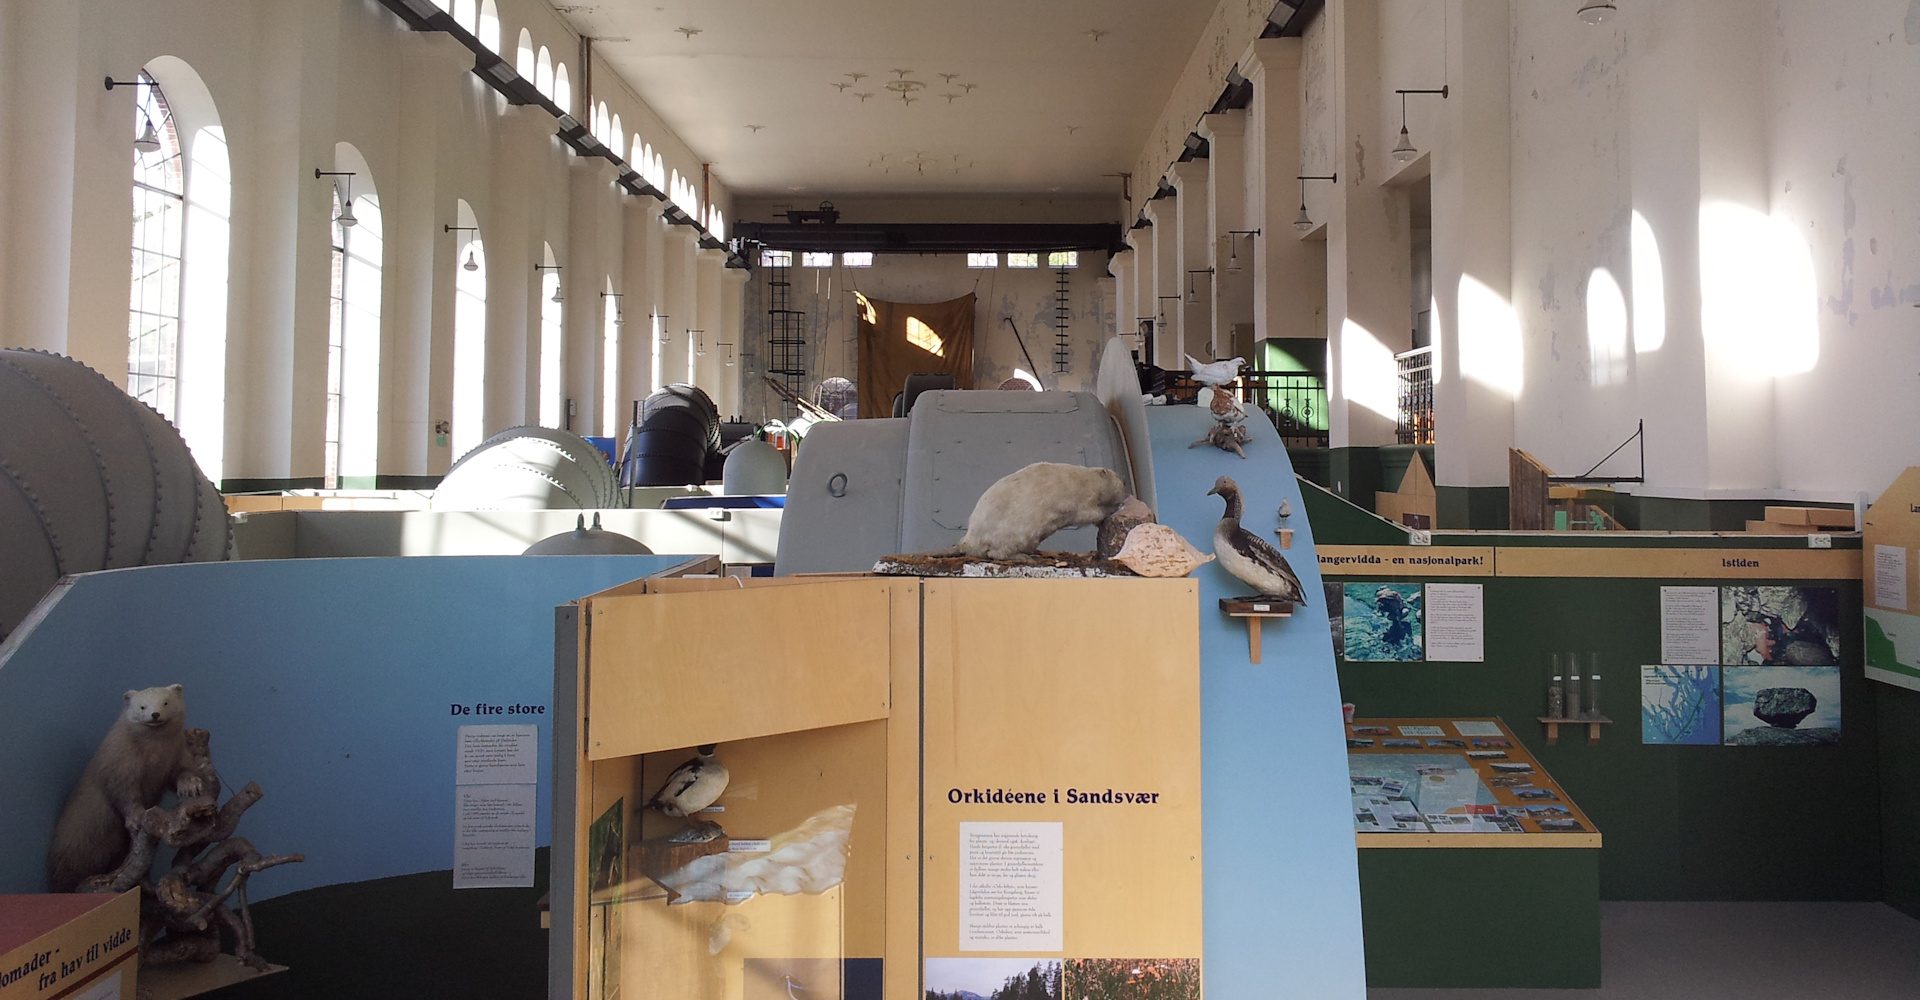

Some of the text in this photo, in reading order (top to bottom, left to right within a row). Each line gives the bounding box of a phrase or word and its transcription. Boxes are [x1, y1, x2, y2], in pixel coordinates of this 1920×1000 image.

[1392, 556, 1405, 564] en
[1409, 556, 1484, 567] nasjonalpark!
[1722, 558, 1760, 568] Istiden
[450, 702, 546, 716] De fire store
[947, 788, 1160, 804] Orkidéene i Sandsvær
[38, 927, 132, 992] fra hav til vidde
